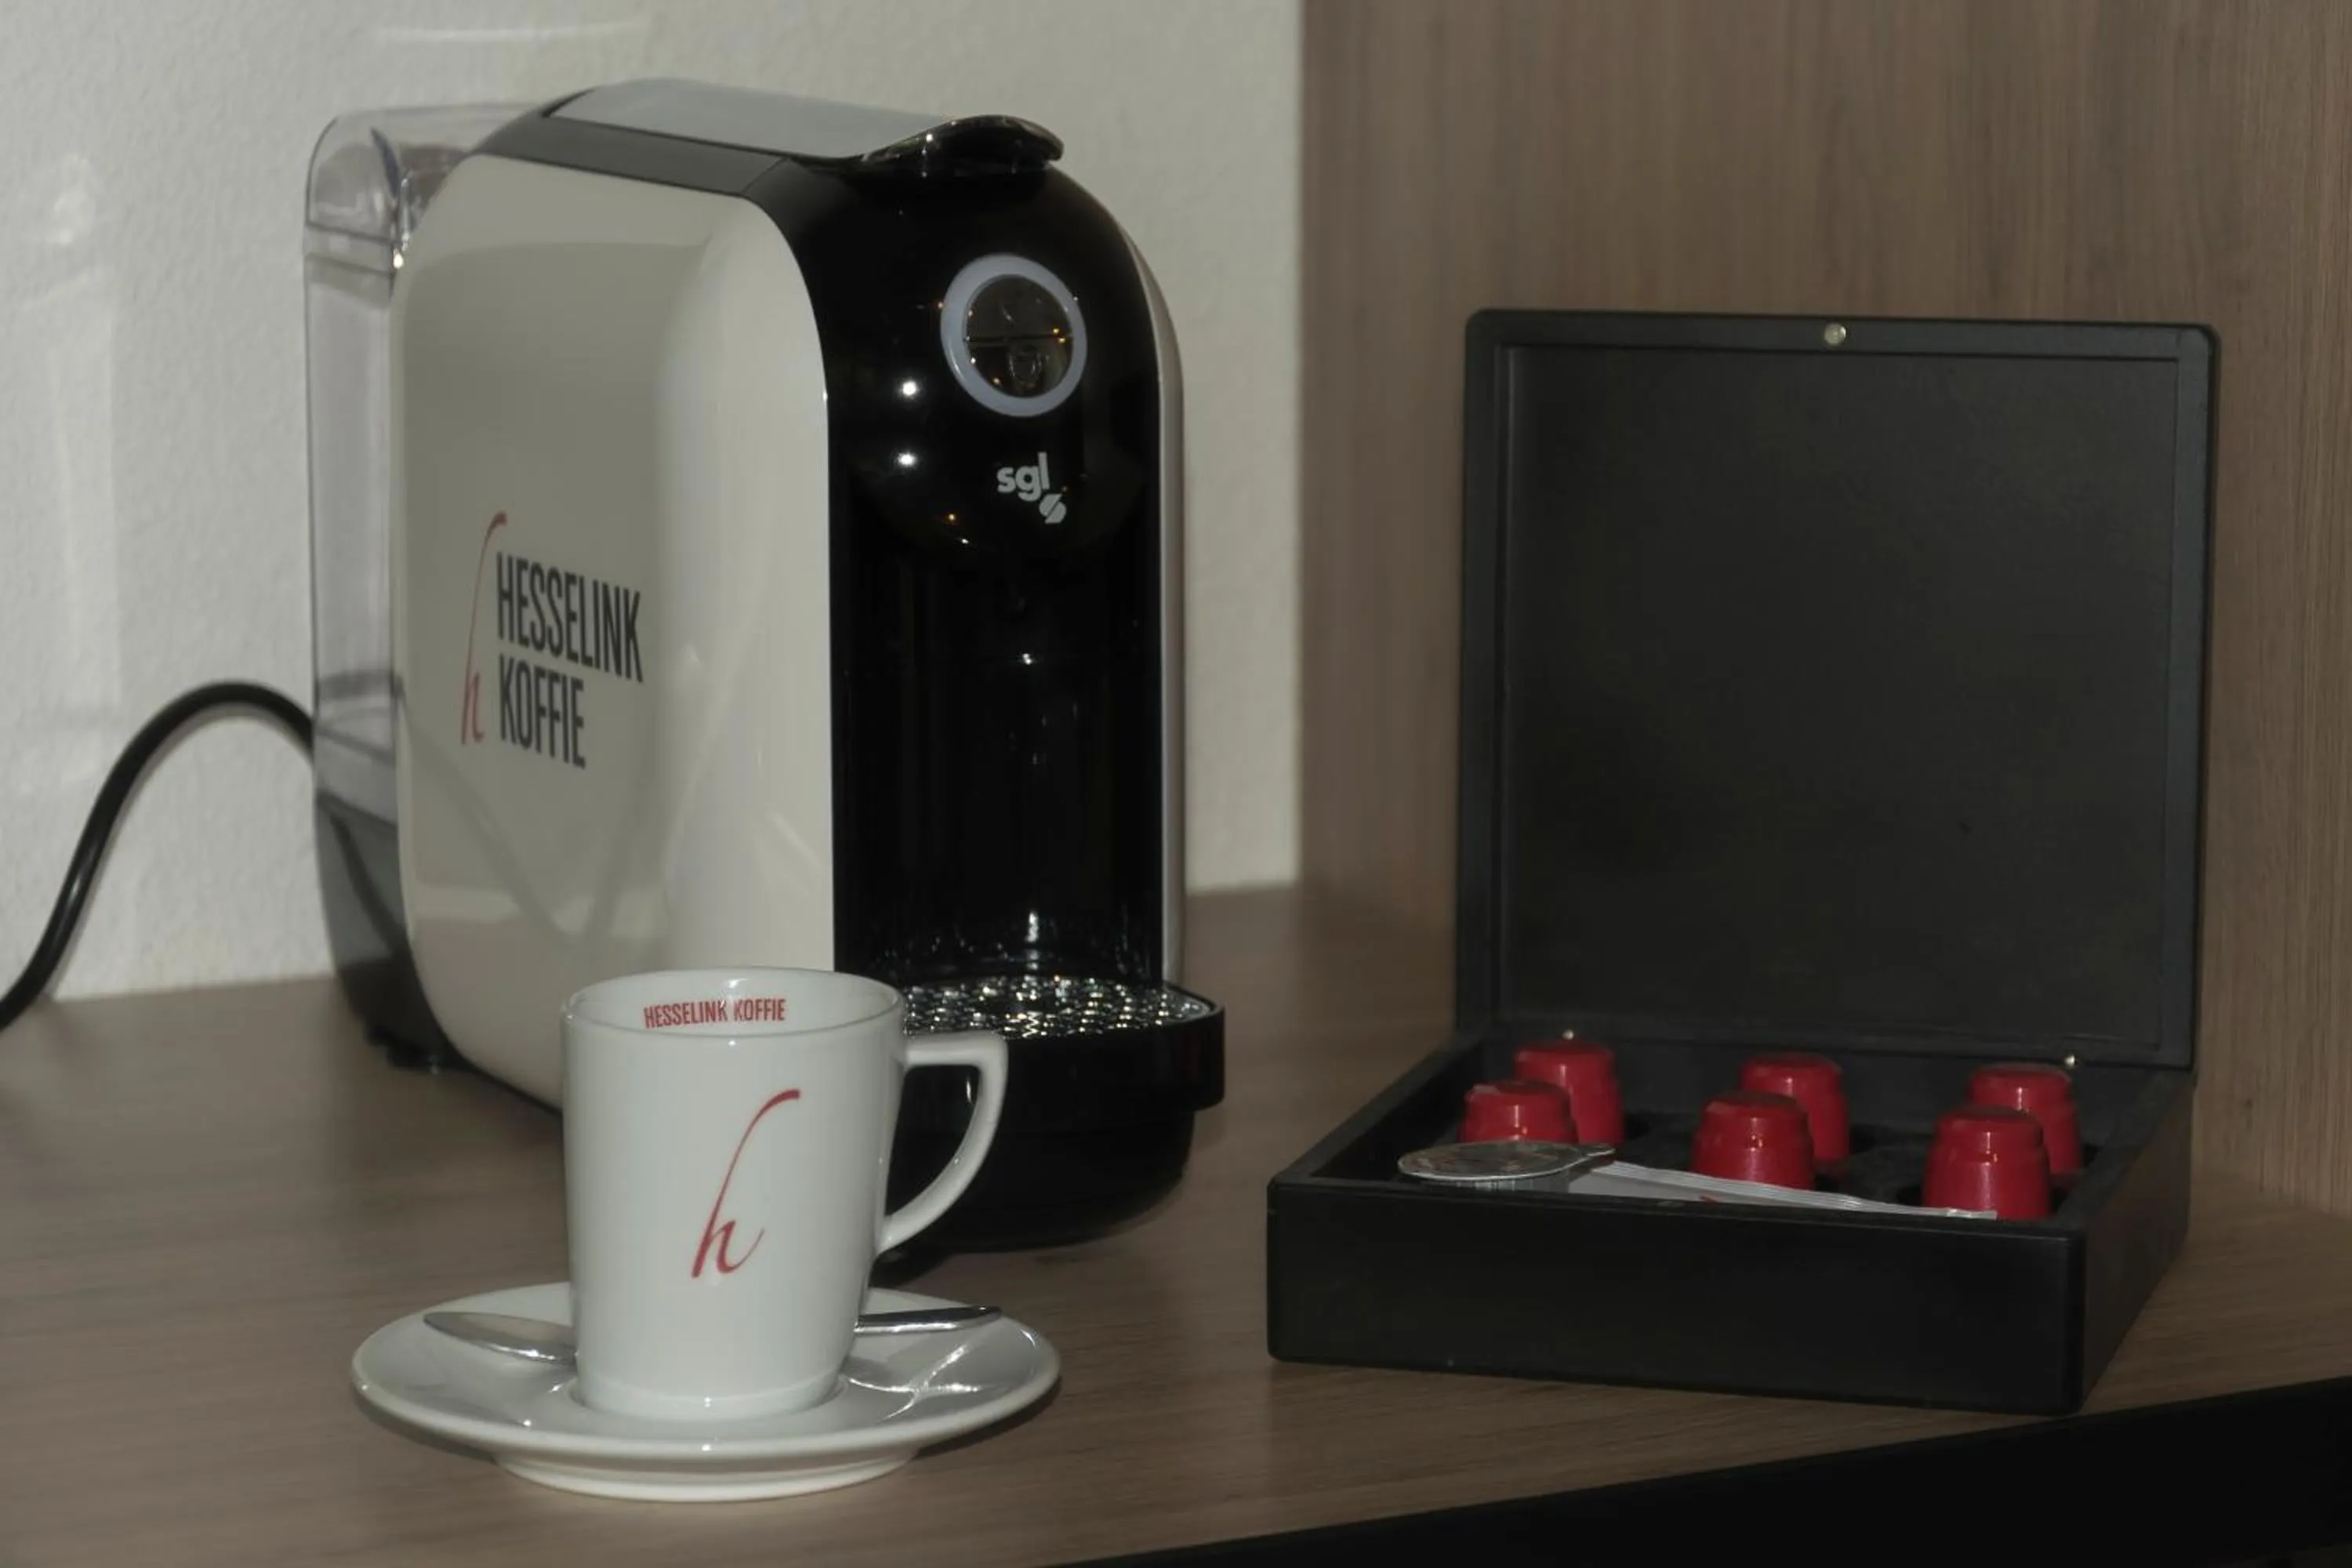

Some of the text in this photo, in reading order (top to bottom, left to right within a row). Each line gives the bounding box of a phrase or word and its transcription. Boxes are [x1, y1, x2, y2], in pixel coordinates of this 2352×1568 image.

[996, 452, 1051, 502] sgl
[496, 551, 643, 683] HESSELINK
[499, 652, 586, 769] KOFFIE
[644, 998, 786, 1029] HESSELINK KOFFIE
